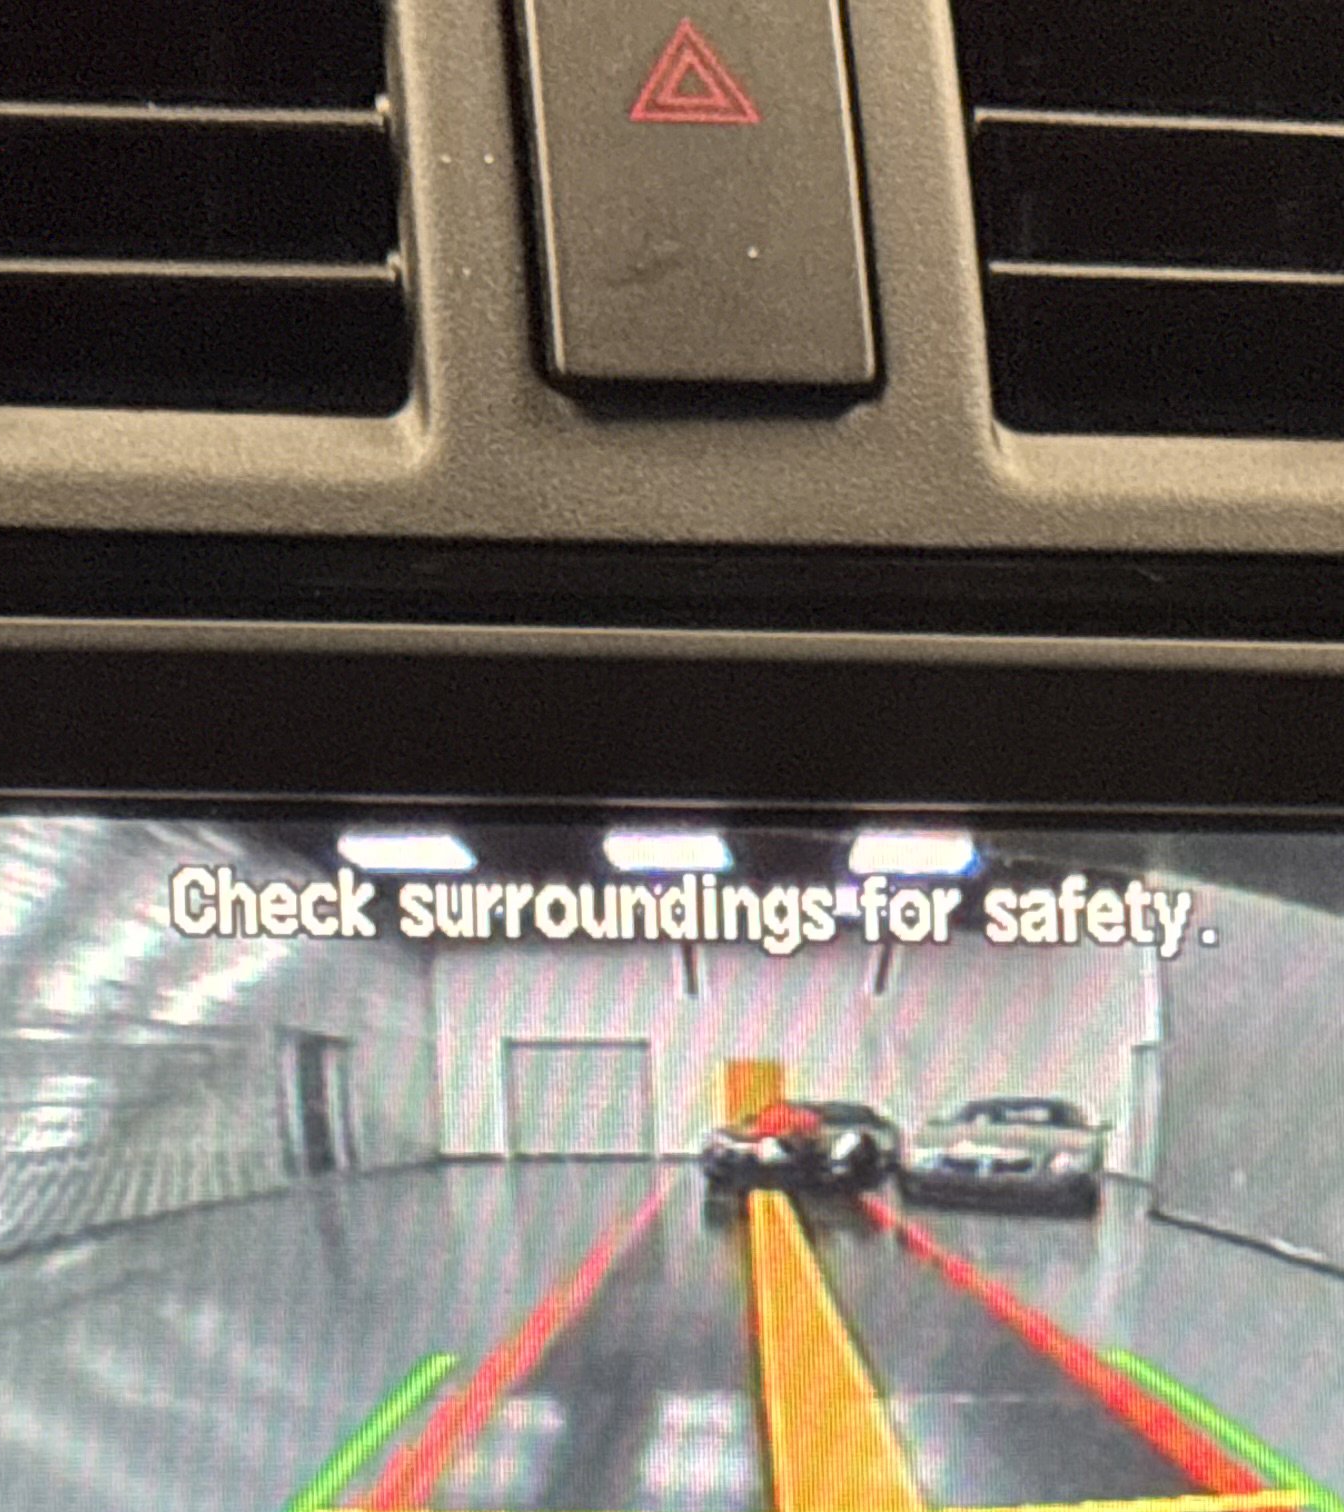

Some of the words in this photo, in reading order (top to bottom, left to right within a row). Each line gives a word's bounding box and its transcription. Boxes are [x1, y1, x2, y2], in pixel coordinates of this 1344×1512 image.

[170, 866, 377, 938] Check
[399, 872, 836, 956] surroundings
[860, 874, 962, 944] for
[981, 874, 1222, 956] safety.
